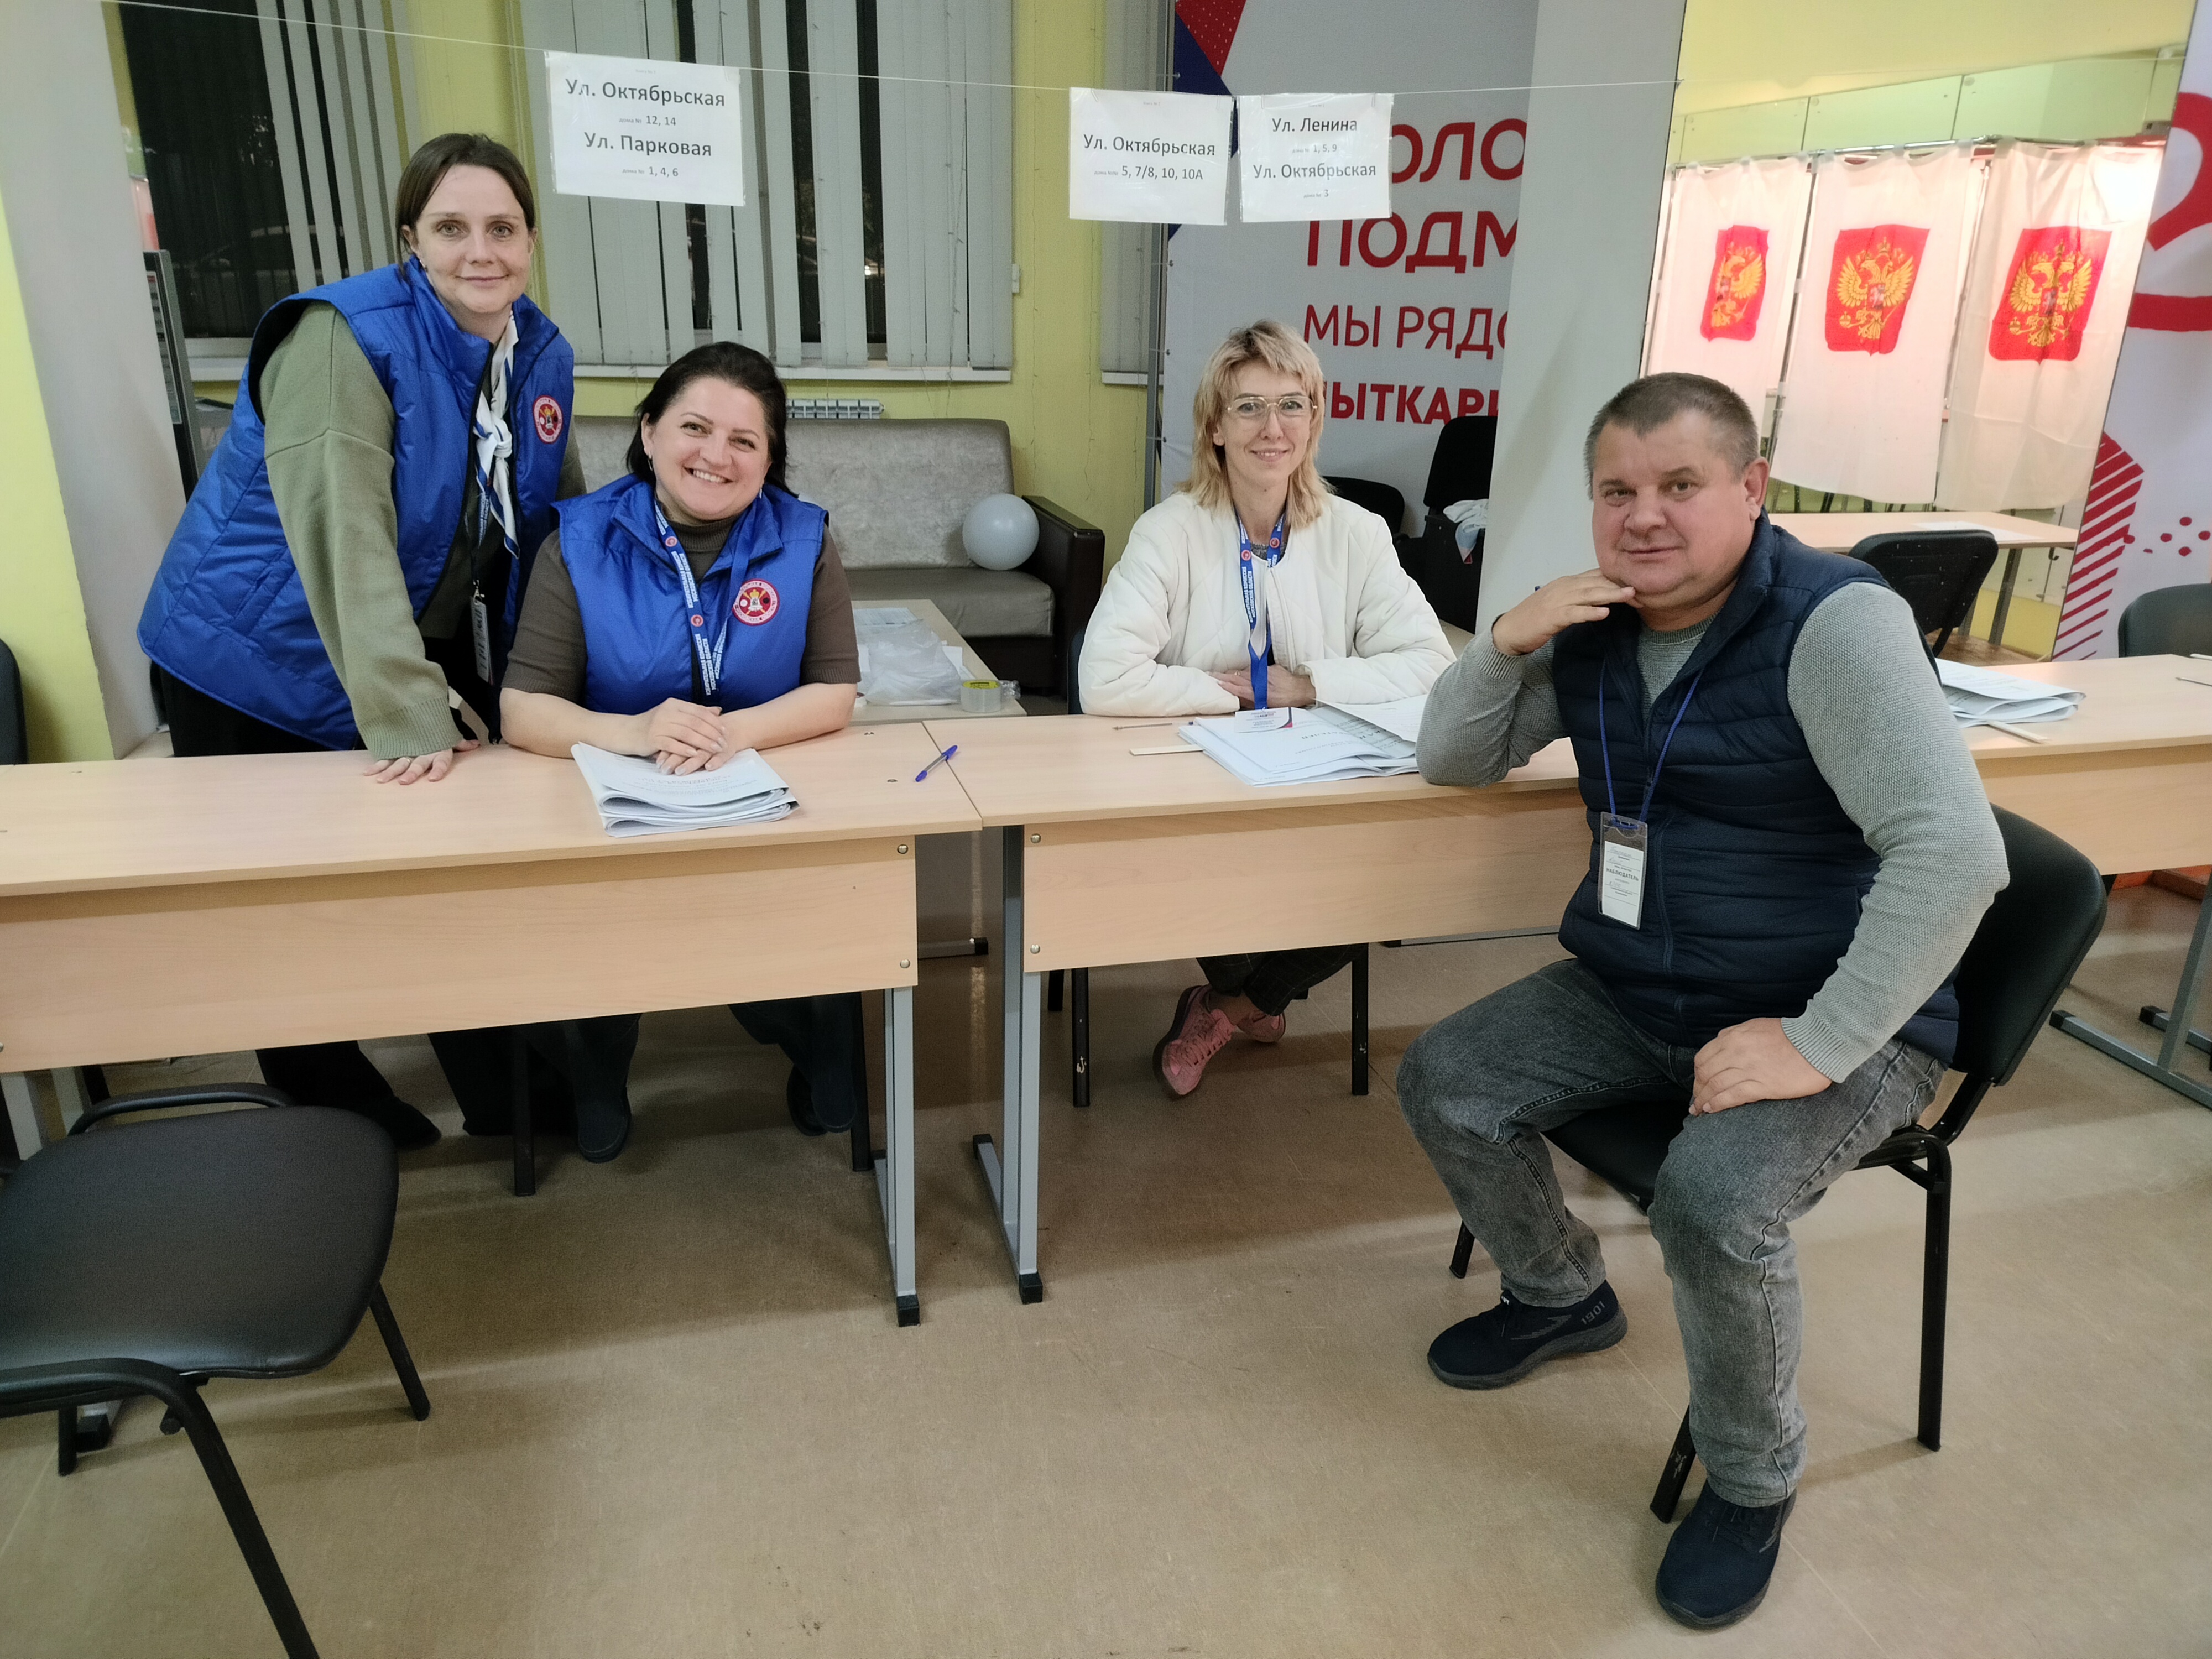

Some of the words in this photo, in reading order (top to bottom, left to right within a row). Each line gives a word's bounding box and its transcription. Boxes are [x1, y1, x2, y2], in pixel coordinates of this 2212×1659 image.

[565, 78, 596, 96] Ул.
[602, 81, 726, 107] Октябрьская
[645, 115, 661, 126] 12,
[664, 116, 676, 126] 14
[1272, 118, 1296, 132] Ул.
[1300, 117, 1358, 132] Ленина
[583, 132, 614, 149] Ул.
[620, 135, 712, 156] Парковая
[1083, 134, 1108, 150] Ул.
[1113, 136, 1215, 156] Октябрьская
[1313, 144, 1321, 154] 1,
[1322, 144, 1330, 153] 5,
[1332, 144, 1337, 152] 9
[648, 166, 658, 177] 1,
[660, 167, 670, 178] 4,
[672, 168, 679, 177] 6
[1121, 165, 1131, 178] 5,
[1135, 165, 1158, 180] 7/8,
[1161, 168, 1178, 180] 10,
[1182, 168, 1203, 180] 10А
[1253, 164, 1276, 179] Ул.
[1281, 163, 1376, 180] Октябрьская
[1303, 304, 1381, 347] МЫ
[1396, 305, 1509, 360] РЯД
[1323, 380, 1499, 425] ЫТКАР
[1606, 867, 1639, 881] НАБЛЮДАТЕЛЬ
[1580, 1301, 1606, 1326] 1901
